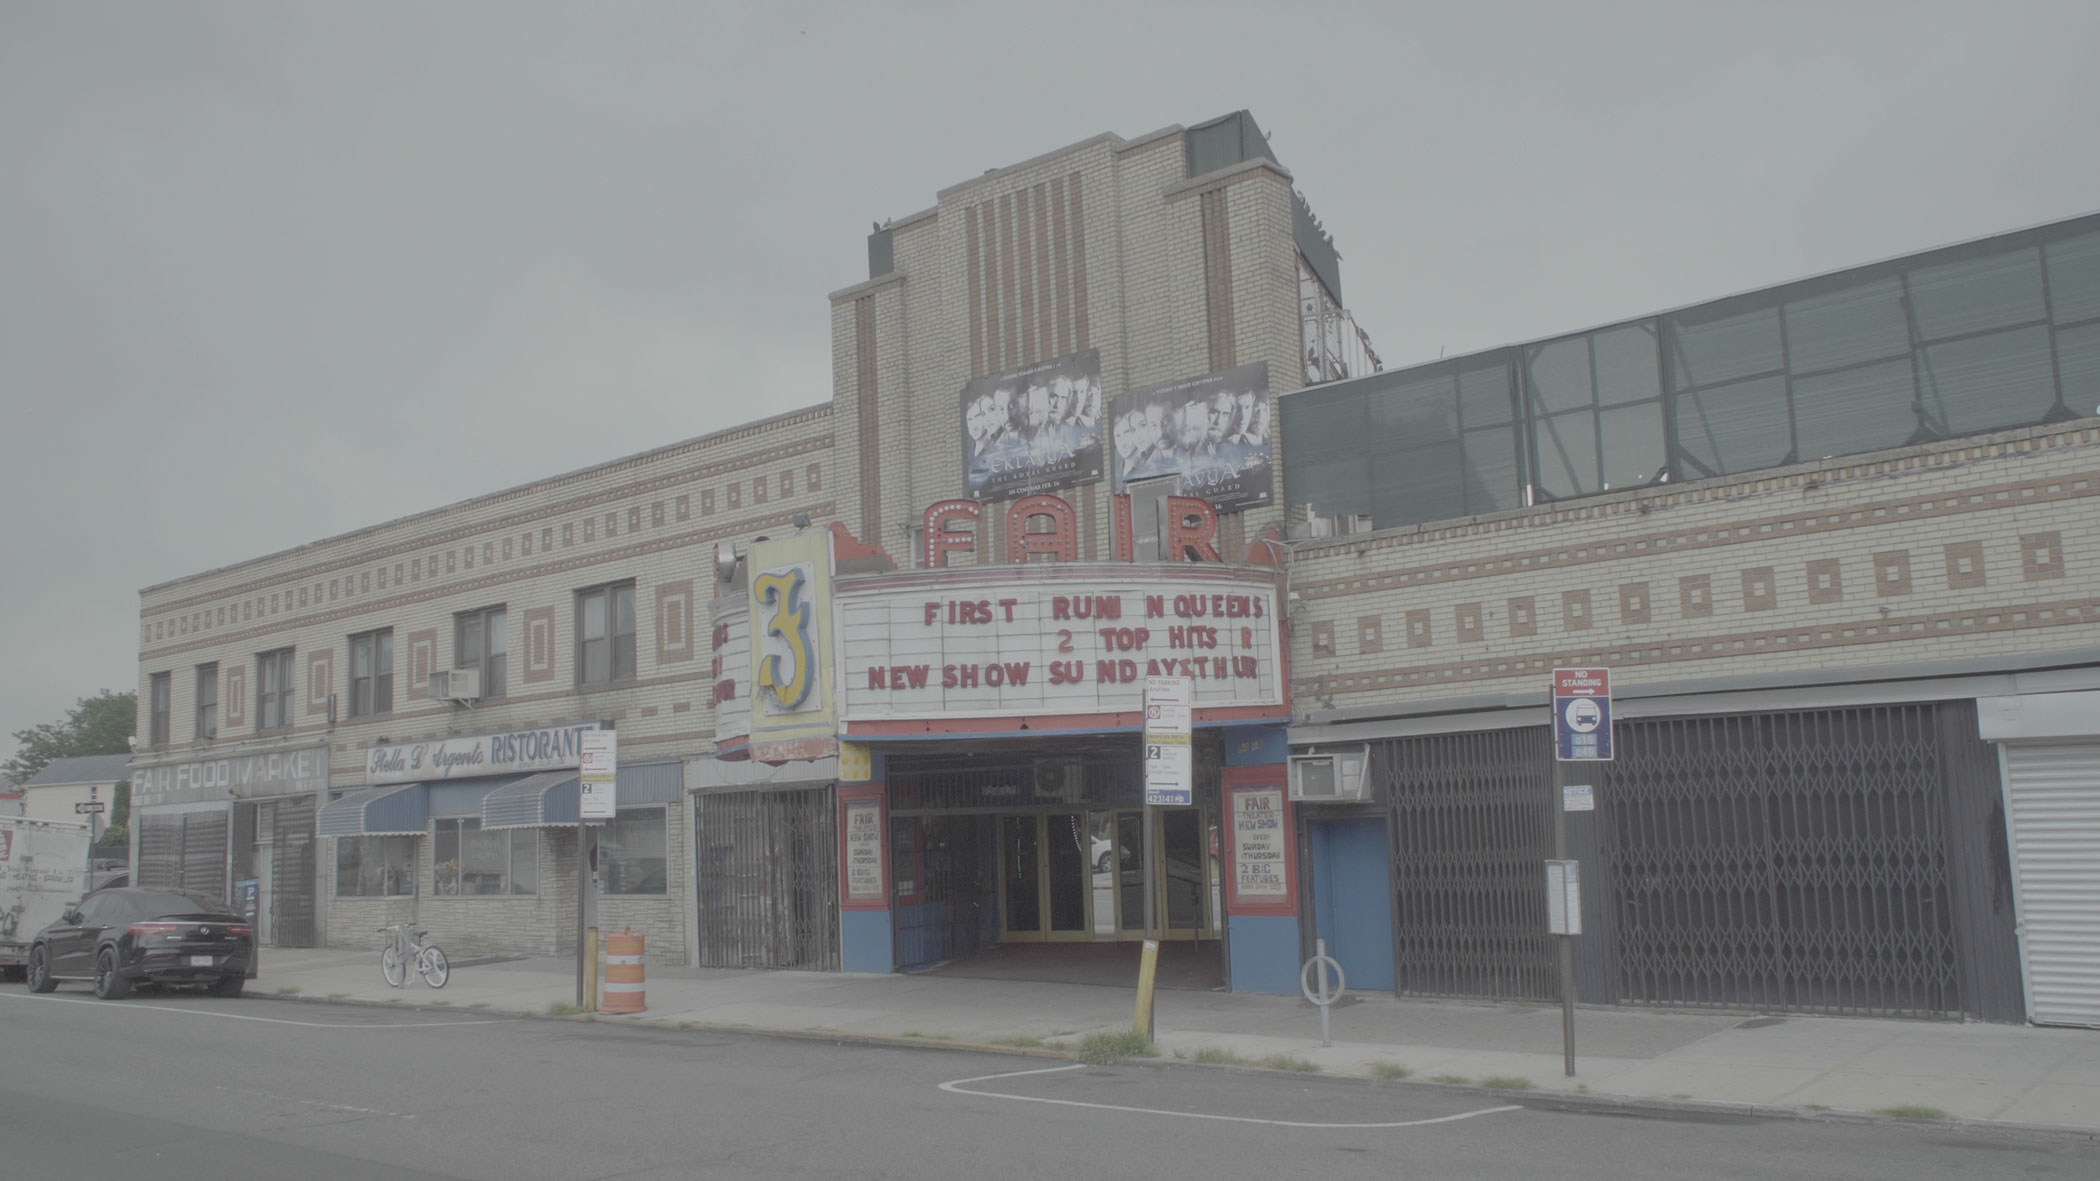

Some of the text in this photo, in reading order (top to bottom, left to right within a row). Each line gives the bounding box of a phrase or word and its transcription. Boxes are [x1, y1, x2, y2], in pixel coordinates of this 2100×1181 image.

[991, 475, 1007, 483] THE
[1206, 483, 1241, 495] GUARD
[923, 493, 1224, 567] FAIR
[925, 598, 1018, 625] FIRST
[1173, 593, 1263, 619] QUEENS
[754, 567, 816, 710] 3
[1058, 628, 1074, 653] 2
[1099, 626, 1150, 652] TOP
[1168, 624, 1218, 649] HITS
[868, 664, 930, 690] NEW
[942, 662, 1030, 688] SHOW
[1575, 671, 1588, 679] NO
[1562, 679, 1602, 687] STANDING
[491, 726, 593, 765] RISTORANT
[1151, 747, 1158, 758] 2
[131, 767, 170, 795] FAIR
[177, 759, 229, 789] FOOD
[237, 749, 321, 785] MARKET
[584, 784, 590, 793] 2
[1245, 797, 1270, 811] FAIR
[854, 813, 874, 825] FAIR
[1238, 819, 1279, 830] NEW SHOW
[1242, 843, 1270, 851] SUNDAY
[1241, 864, 1271, 873] 2 BIG
[1240, 874, 1280, 884] FEATURES
